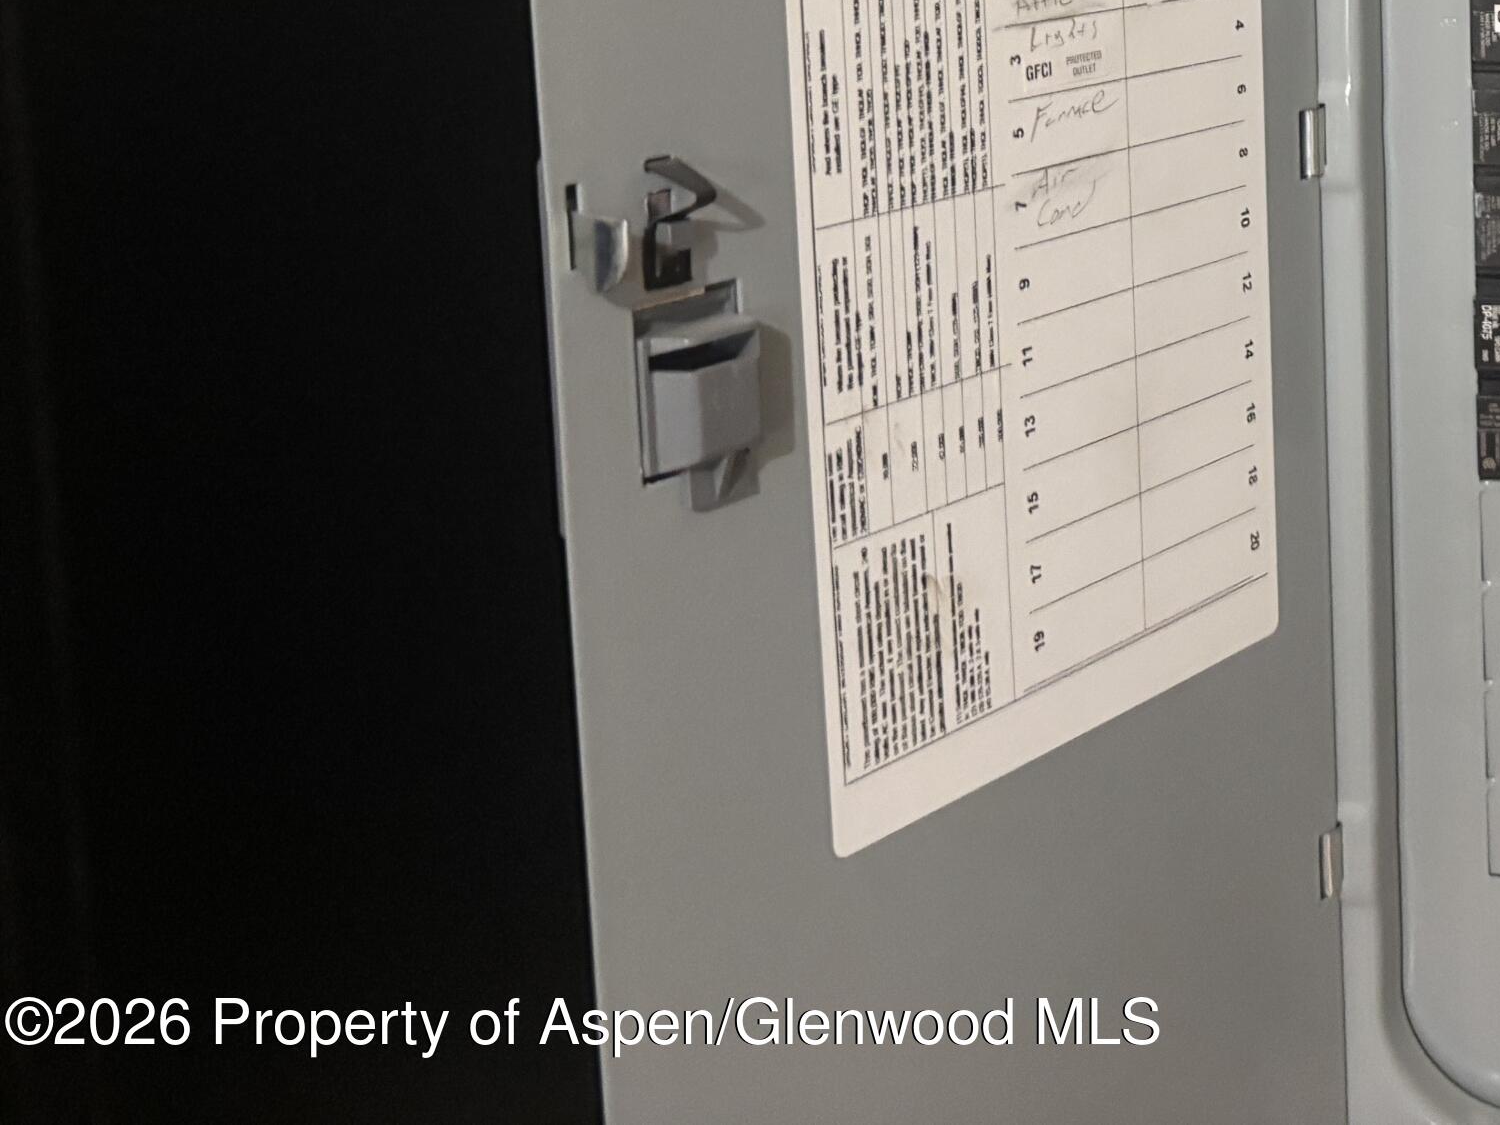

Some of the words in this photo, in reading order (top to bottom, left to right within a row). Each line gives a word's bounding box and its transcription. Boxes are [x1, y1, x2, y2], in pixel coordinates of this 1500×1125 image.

[1235, 20, 1245, 30] 4
[1010, 55, 1021, 65] 3
[1066, 50, 1102, 66] PROTECTED
[1026, 61, 1052, 82] GFCI
[1073, 63, 1097, 77] OUTLET
[1237, 84, 1247, 94] 6
[1013, 127, 1024, 138] 5
[1239, 147, 1249, 158] 8
[1015, 201, 1027, 212] 7
[1240, 206, 1250, 228] 10
[1018, 276, 1030, 291] 9
[1241, 271, 1252, 293] 12
[1021, 343, 1032, 368] 11
[1243, 338, 1254, 360] 14
[1245, 401, 1256, 423] 16
[1024, 413, 1036, 438] 13
[1247, 464, 1258, 486] 18
[1027, 489, 1039, 515] 15
[1249, 529, 1260, 552] 20
[1030, 561, 1041, 585] 17
[1033, 627, 1045, 653] 19
